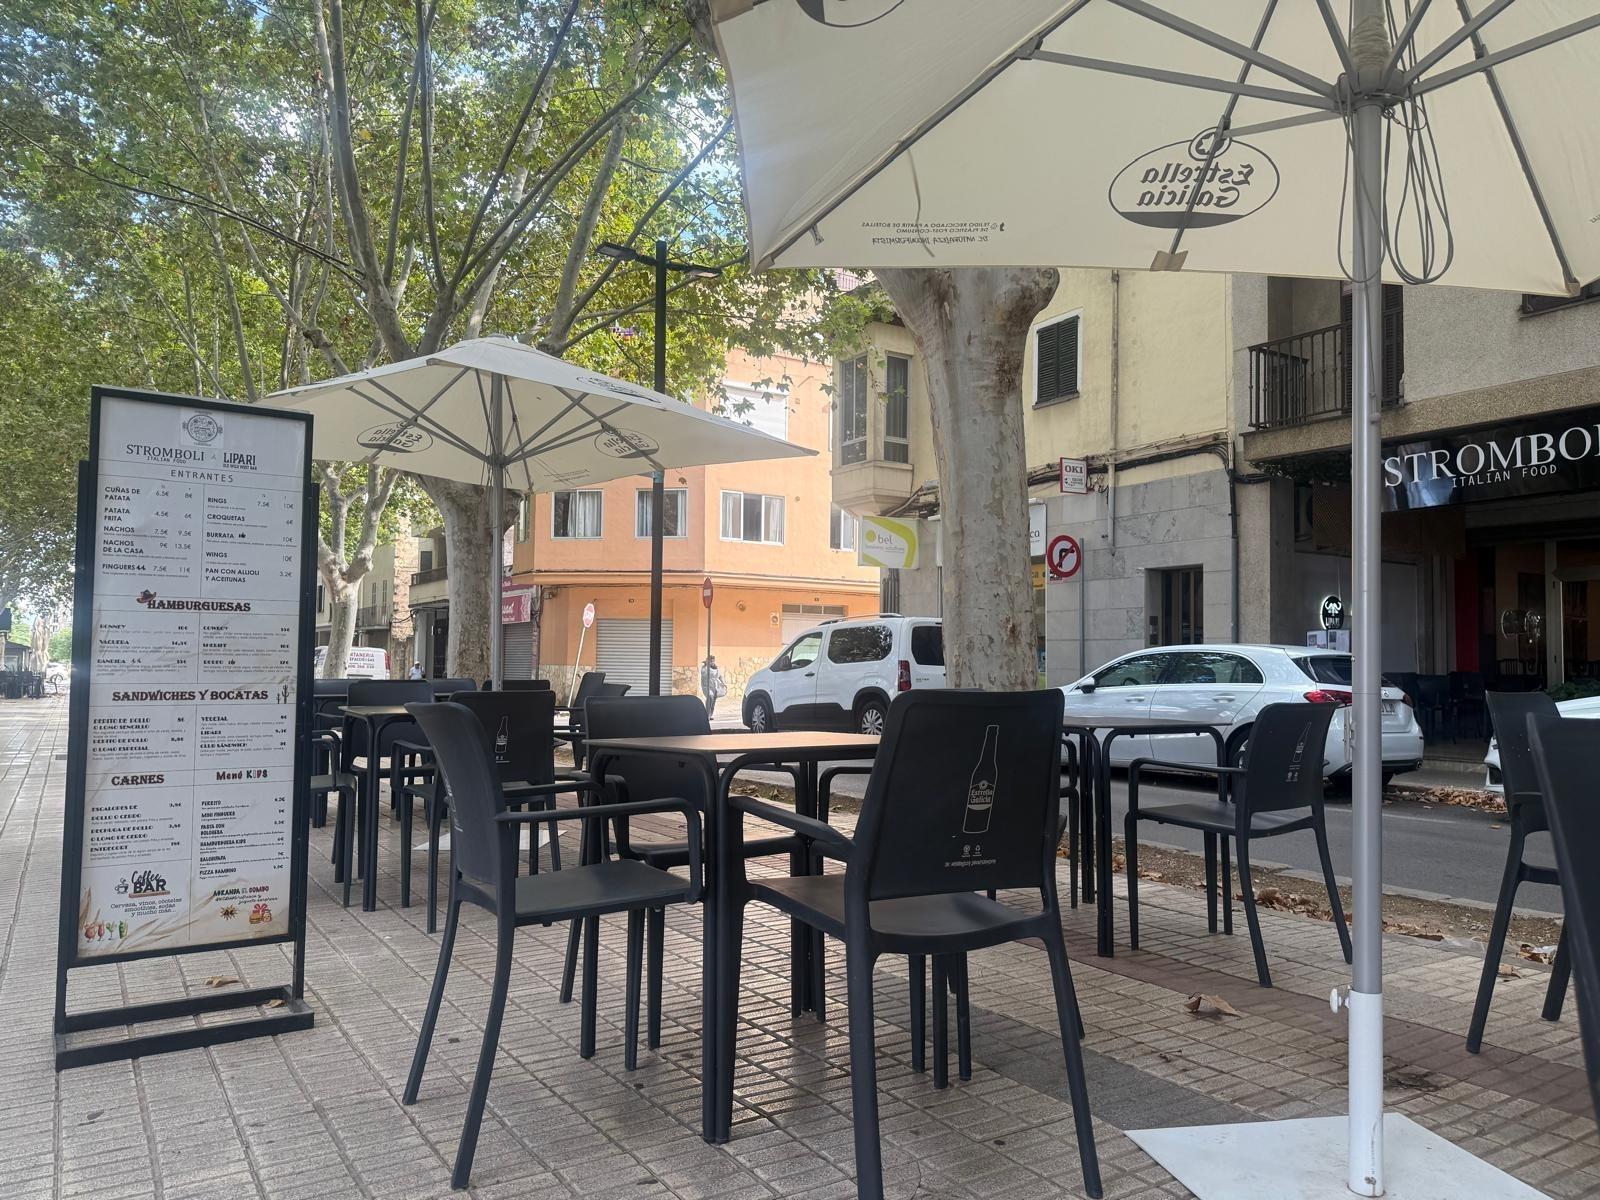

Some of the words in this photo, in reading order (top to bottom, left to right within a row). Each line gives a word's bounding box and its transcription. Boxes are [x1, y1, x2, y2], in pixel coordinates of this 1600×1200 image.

[126, 444, 205, 461] STROMBOLI
[223, 452, 256, 466] LIPARI
[1064, 464, 1083, 474] OKI
[170, 469, 234, 483] ENTRANTES
[1453, 470, 1511, 488] ITALIAN
[1522, 464, 1557, 478] FOOD
[104, 486, 130, 494] CUÑAS
[207, 513, 245, 522] CROQUETAS
[206, 531, 235, 539] BURRATA
[103, 539, 135, 547] NACHOS
[102, 563, 135, 571] FINGUERS
[146, 599, 251, 612] HAMBURGUESAS
[112, 689, 196, 701] SANDWICHES
[198, 688, 209, 700] Y
[210, 690, 269, 700] BOCATAS
[111, 774, 165, 786] CARNES
[131, 870, 162, 884] Coffee
[133, 878, 167, 894] BAR
